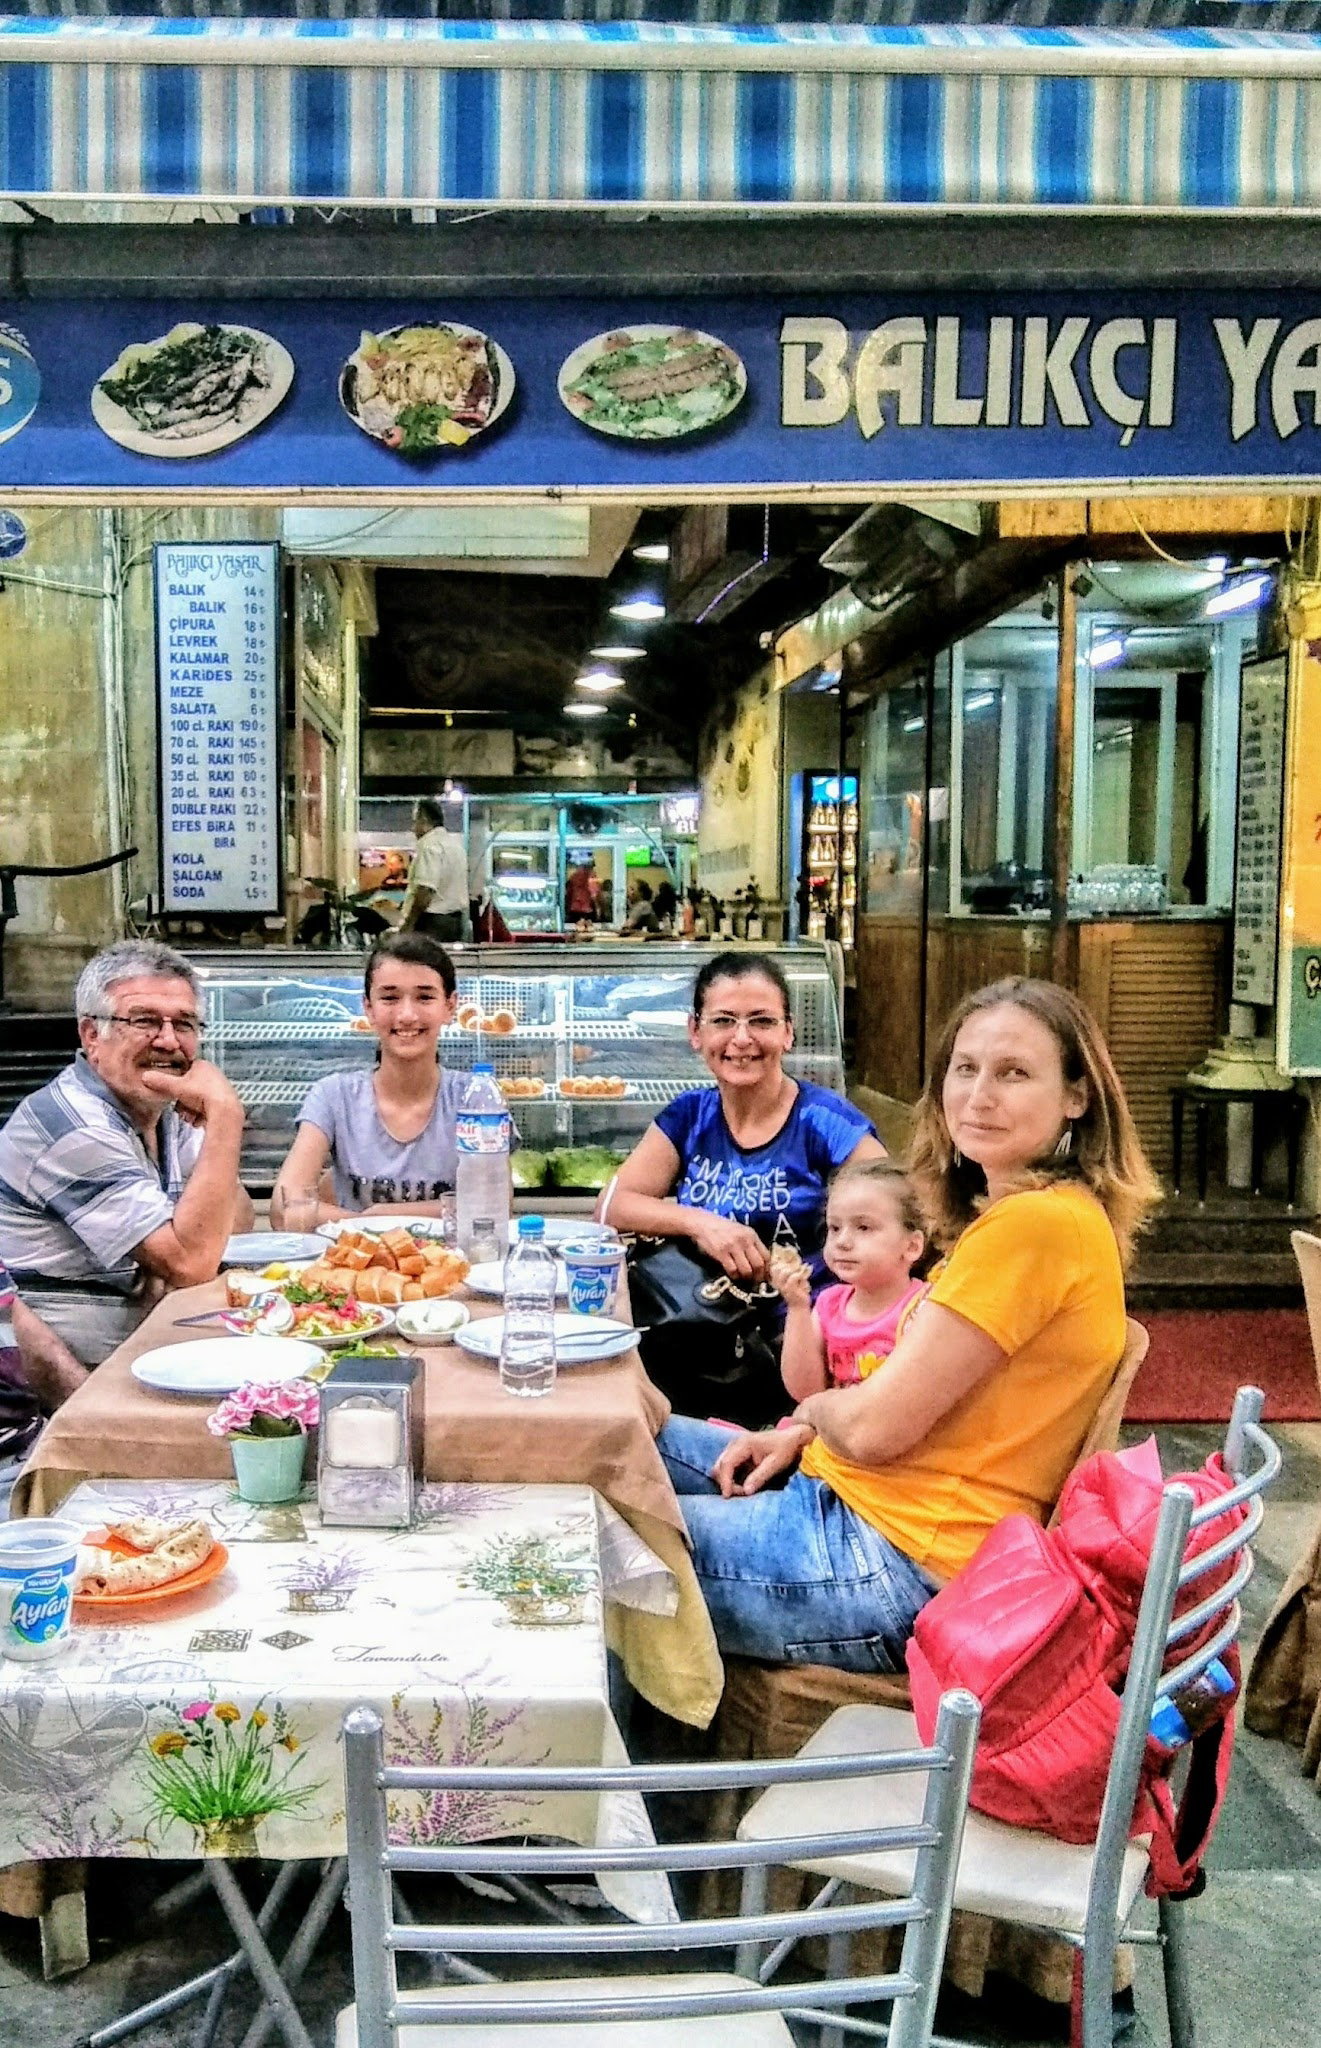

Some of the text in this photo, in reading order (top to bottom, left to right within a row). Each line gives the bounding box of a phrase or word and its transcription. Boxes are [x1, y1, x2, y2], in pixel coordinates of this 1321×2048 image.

[780, 316, 1178, 447] BALIKÇI
[169, 584, 257, 597] BALIK 14
[189, 601, 258, 615] BALIK 16
[169, 635, 218, 648] LEVREK
[170, 652, 259, 665] KALAMAR 20
[244, 670, 258, 682] 25
[170, 686, 204, 698] MEZE
[170, 702, 217, 715] SALATA
[171, 720, 189, 732] 100
[208, 720, 234, 732] RAKI
[170, 736, 184, 748] 70
[208, 736, 234, 748] RAKI
[171, 753, 184, 765] 50
[208, 753, 234, 765] RAKI
[171, 770, 184, 782] 35
[208, 770, 235, 782] RAKI
[171, 786, 184, 799] 20
[208, 787, 235, 799] RAKI
[172, 803, 207, 815] DUBLE
[210, 803, 236, 815] RAKI
[171, 820, 201, 832] EFES
[172, 853, 205, 865] KOLA
[173, 886, 206, 898] SODA
[572, 1284, 607, 1304] Ayran
[12, 1595, 68, 1630] Ayran
